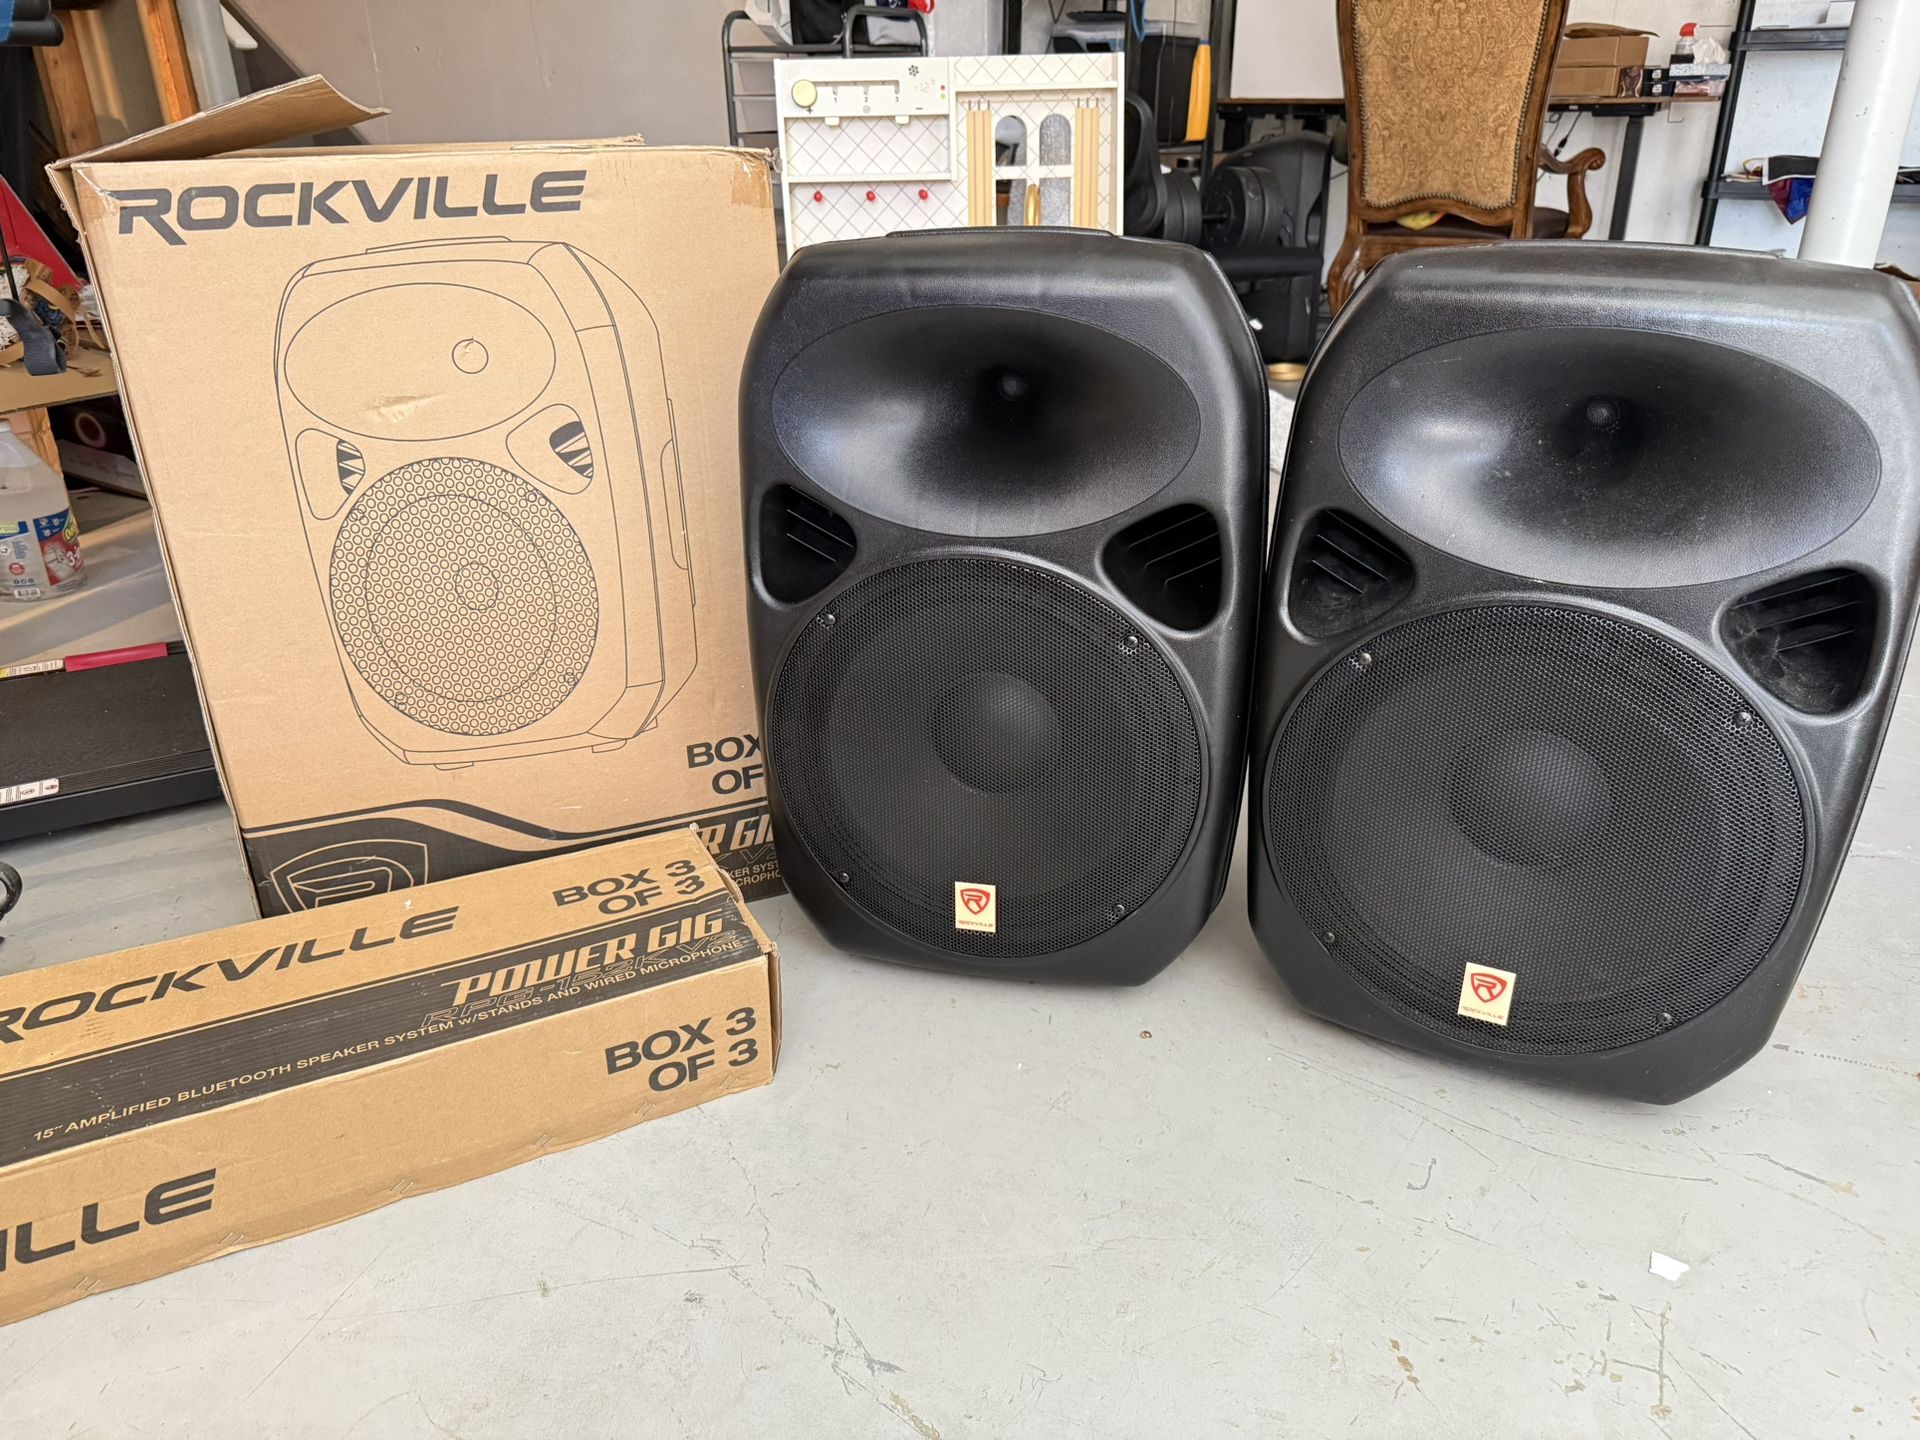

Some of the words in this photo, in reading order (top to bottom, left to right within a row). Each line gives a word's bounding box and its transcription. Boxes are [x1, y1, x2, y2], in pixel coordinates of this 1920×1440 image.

[114, 170, 587, 246] ROCKVILLE
[687, 734, 761, 768] BOX
[712, 764, 765, 795] OF
[552, 868, 658, 907] BOX
[665, 859, 696, 877] 3
[598, 885, 662, 914] OF
[674, 875, 705, 895] 3
[440, 932, 637, 1006] POWER
[647, 908, 722, 953] GIG
[64, 1096, 171, 1133] AMPLIFIED
[177, 1063, 291, 1102] BLUETOOTH
[296, 1039, 380, 1069] SPEAKER
[384, 1020, 454, 1045] SYSTEM
[458, 997, 543, 1025] w/STANDS
[547, 986, 581, 1002] AND
[584, 970, 636, 991] WIRED
[641, 939, 744, 976] MICROPHONE
[605, 1017, 715, 1075] BOX
[726, 1006, 756, 1036] 3
[648, 1048, 715, 1092] OF
[728, 1038, 758, 1067] 3
